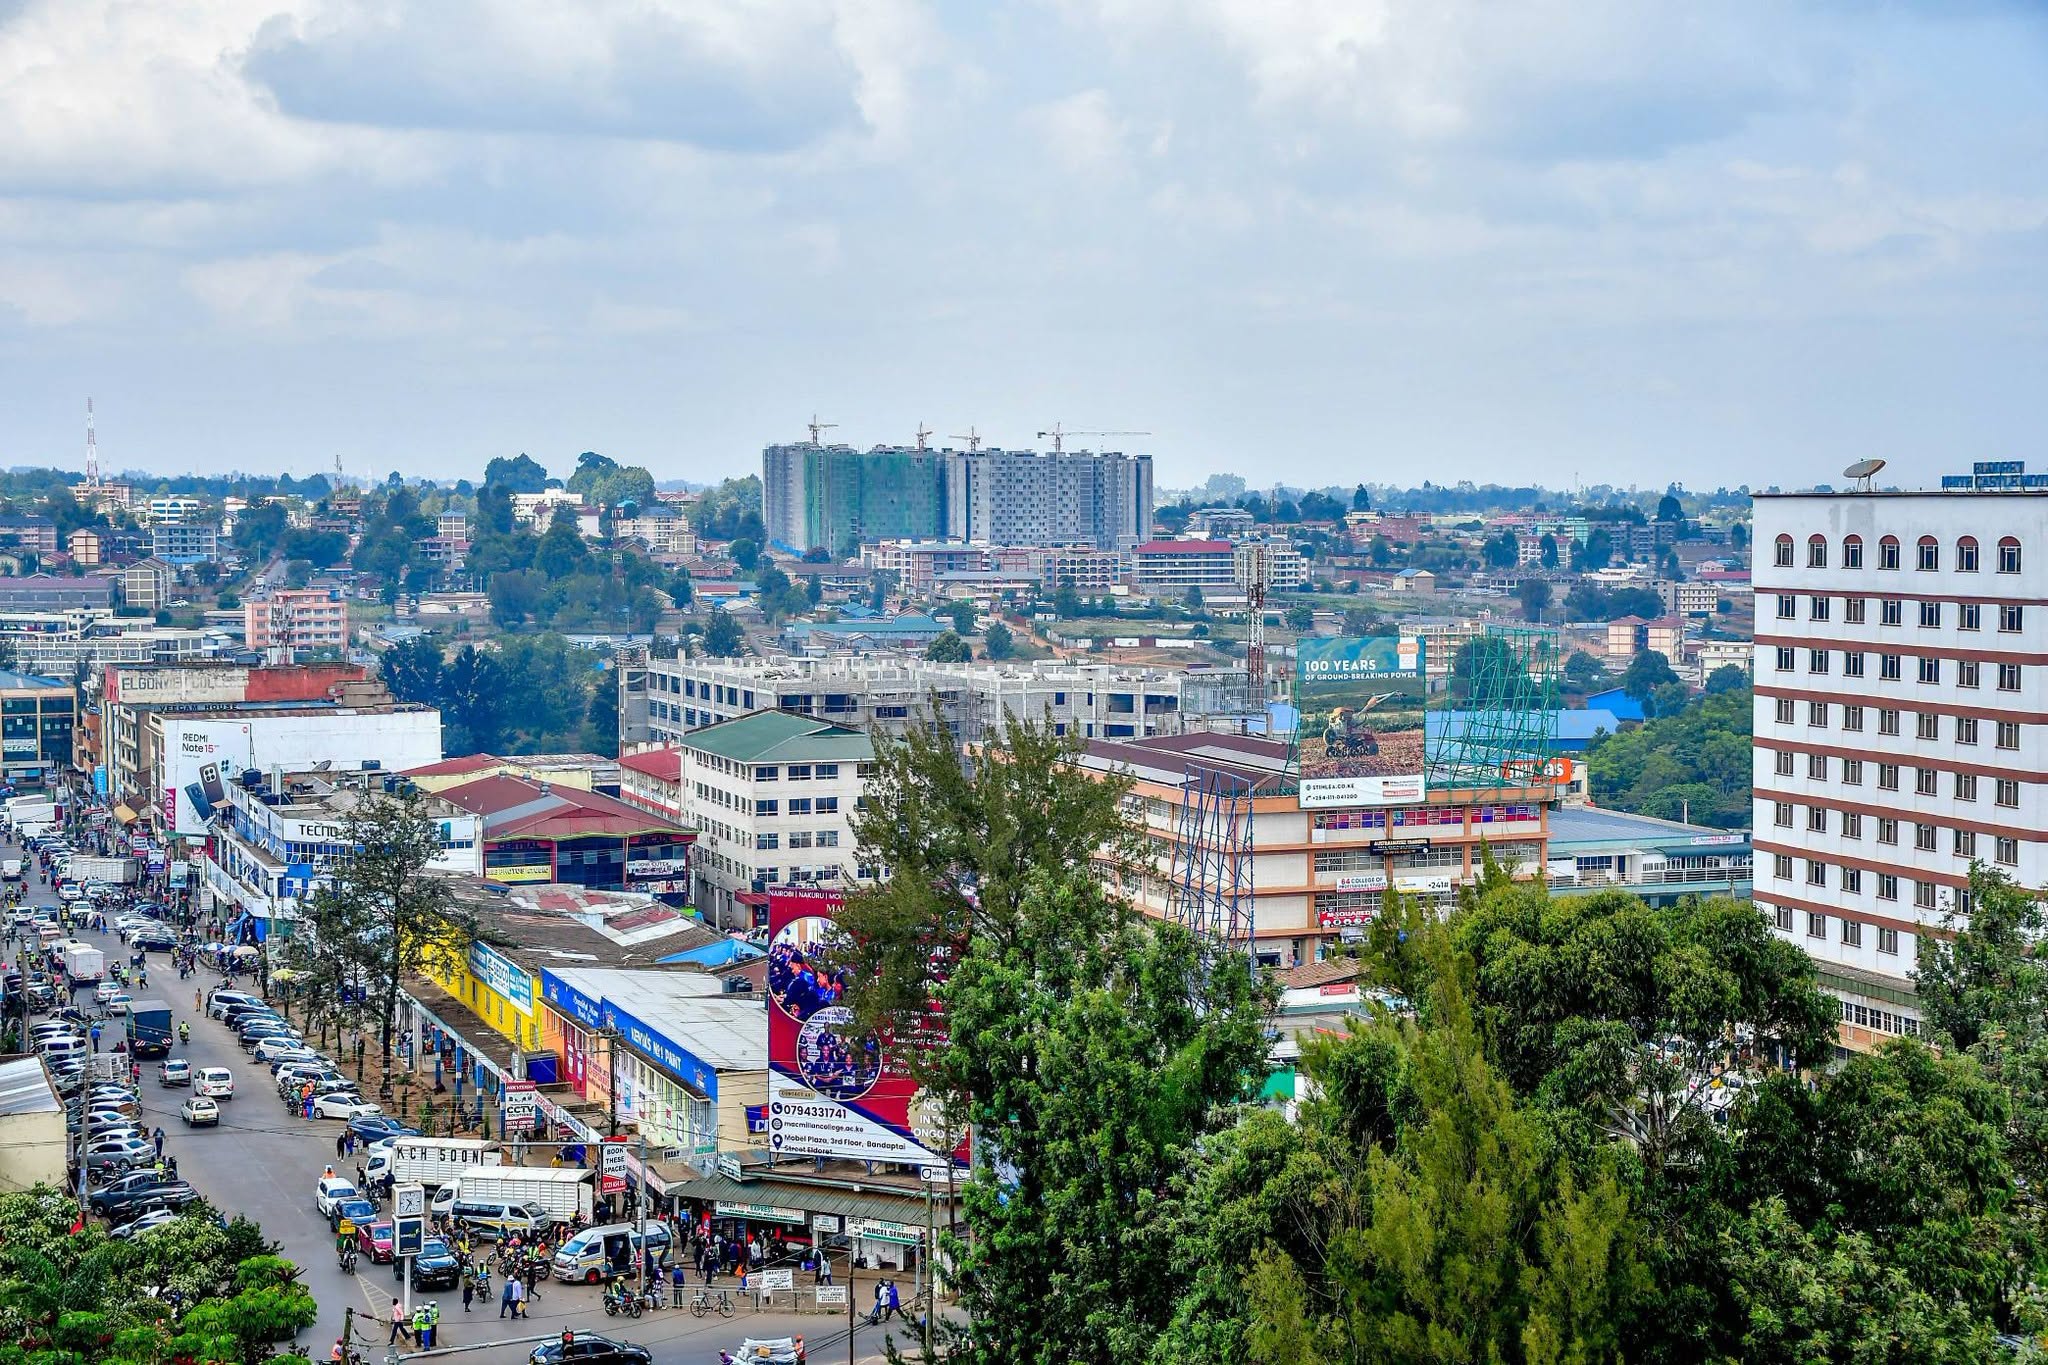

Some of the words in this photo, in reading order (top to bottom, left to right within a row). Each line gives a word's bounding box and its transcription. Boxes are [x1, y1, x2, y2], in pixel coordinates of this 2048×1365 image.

[1304, 661, 1328, 672] 100
[1333, 660, 1376, 671] YEARS
[182, 743, 203, 753] Note
[204, 745, 214, 753] 15
[799, 891, 824, 899] NAKURU
[665, 1048, 682, 1071] PAINT
[506, 1105, 534, 1114] CCTV
[783, 1105, 847, 1119] 0794331741
[784, 1122, 864, 1133] macmillancollege.ac.ke
[784, 1134, 807, 1142] Mobel
[830, 1137, 842, 1145] 3rd
[843, 1138, 864, 1148] Floor,
[867, 1142, 906, 1150] Bandaptai
[397, 1147, 427, 1160] KCH
[784, 1145, 806, 1153] Street
[807, 1147, 833, 1155] Eldoret
[605, 1157, 625, 1165] THESE
[603, 1166, 626, 1174] SPACES
[848, 1218, 865, 1226] GREAT
[880, 1222, 904, 1231] EXPRESS
[863, 1227, 886, 1236] PARCEL
